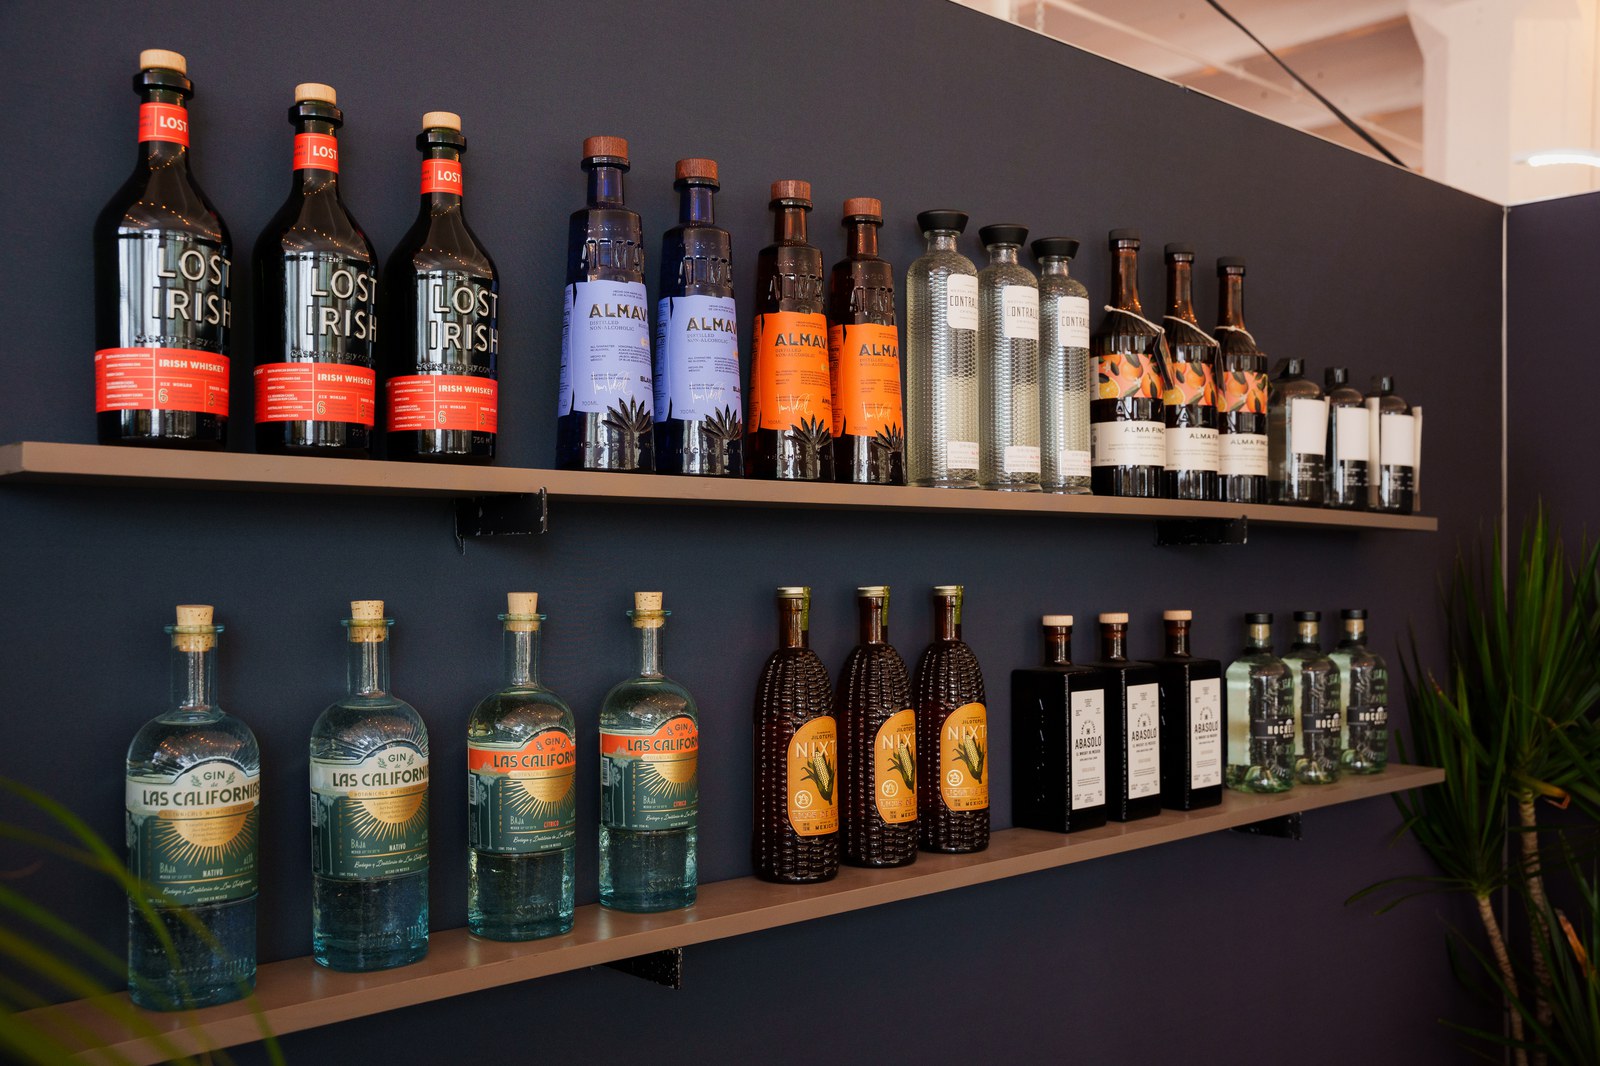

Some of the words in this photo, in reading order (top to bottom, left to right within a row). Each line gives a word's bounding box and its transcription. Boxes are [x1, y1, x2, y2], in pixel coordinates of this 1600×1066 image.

[160, 115, 187, 133] LOST
[312, 145, 337, 161] LOST
[437, 170, 461, 184] LOST
[158, 247, 231, 288] LOST
[311, 267, 377, 305] LOST
[153, 287, 232, 329] IRISH
[433, 285, 498, 319] LOST
[306, 305, 377, 343] IRISH
[429, 321, 498, 355] IRISH
[159, 359, 187, 369] IRISH
[190, 361, 224, 373] WHISKEY
[317, 373, 342, 382] IRISH
[158, 388, 168, 403] 6
[438, 384, 463, 393] IRISH
[464, 385, 493, 396] WHISKEY
[316, 400, 326, 415] 6
[438, 410, 447, 424] 6
[675, 723, 688, 731] GIN
[1194, 720, 1218, 734] ABASOLO
[545, 737, 560, 745] GIN
[1131, 727, 1157, 742] ABASOLO
[628, 740, 651, 751] LAS
[1075, 735, 1102, 750] ABASOLO
[388, 753, 407, 762] GIN
[494, 755, 518, 768] LAS
[203, 770, 225, 780] GIN
[332, 772, 358, 787] LAS
[143, 790, 169, 806] LAS
[351, 838, 366, 849] BAJA
[389, 842, 406, 852] NATIVO
[160, 862, 177, 873] BAJA
[202, 868, 224, 878] NATIVO
